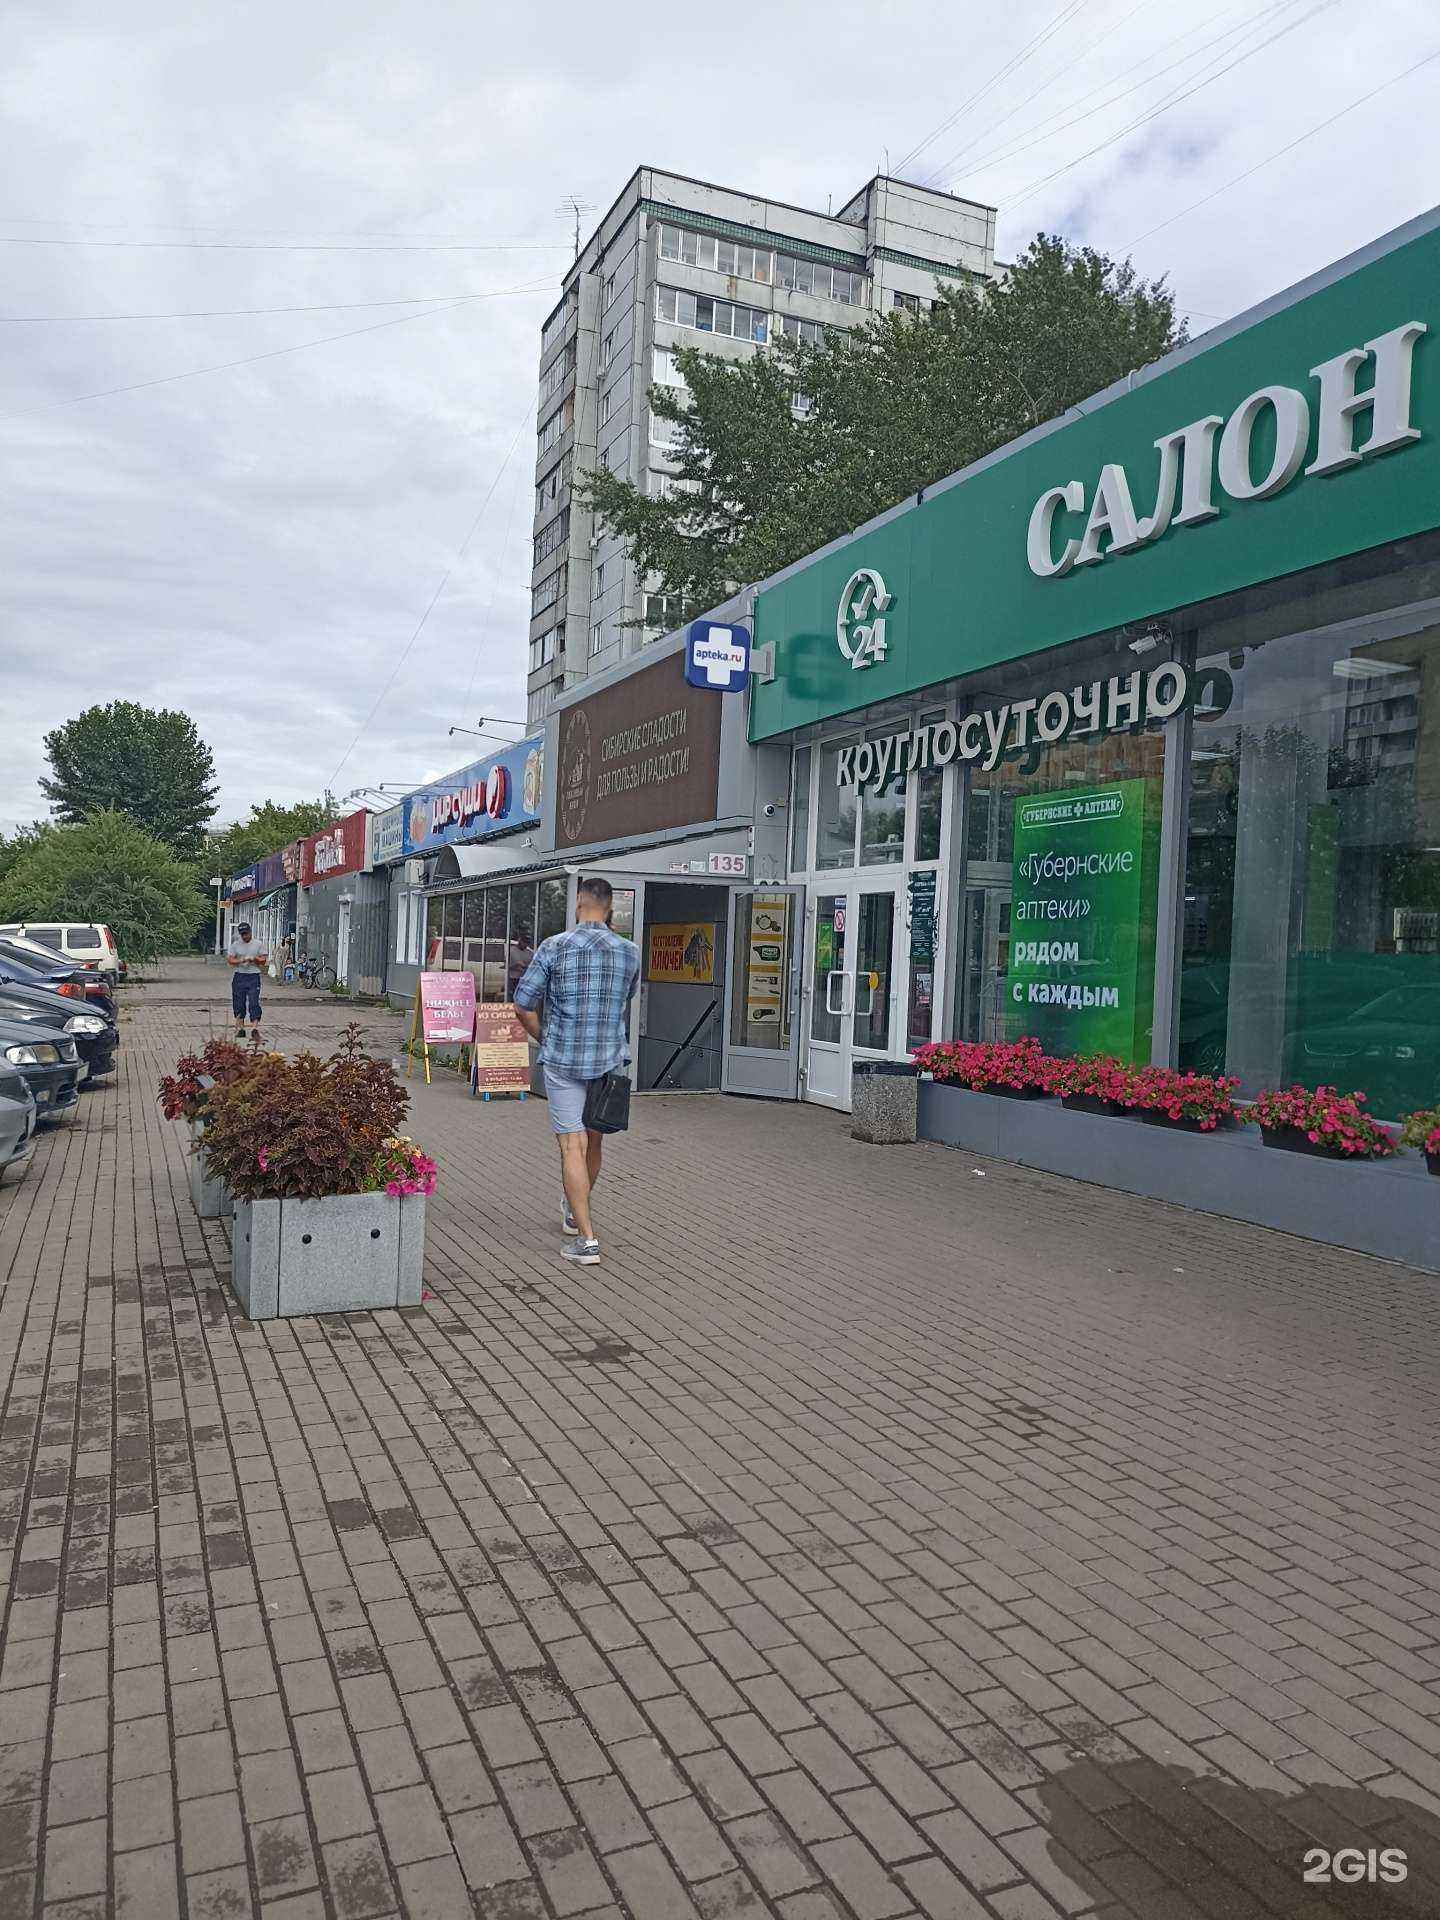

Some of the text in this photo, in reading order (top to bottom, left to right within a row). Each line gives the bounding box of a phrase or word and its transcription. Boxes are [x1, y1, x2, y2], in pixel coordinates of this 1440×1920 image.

[1027, 320, 1428, 577] САЛОН
[696, 649, 742, 662] apteka.ru
[851, 618, 887, 669] 24
[601, 708, 687, 761] СИБИРСКИЕ СЛАДОСТИ
[640, 760, 648, 785] И
[648, 747, 690, 784] РАДОСТИ!
[1025, 799, 1117, 822] ГУБЕРНСКИЕ АПТЕКИ
[710, 855, 745, 872] 135
[1018, 850, 1133, 885] «Губернские
[1016, 898, 1091, 920] аптеки»
[1014, 941, 1079, 966] рядом
[1012, 983, 1119, 1009] с каждым
